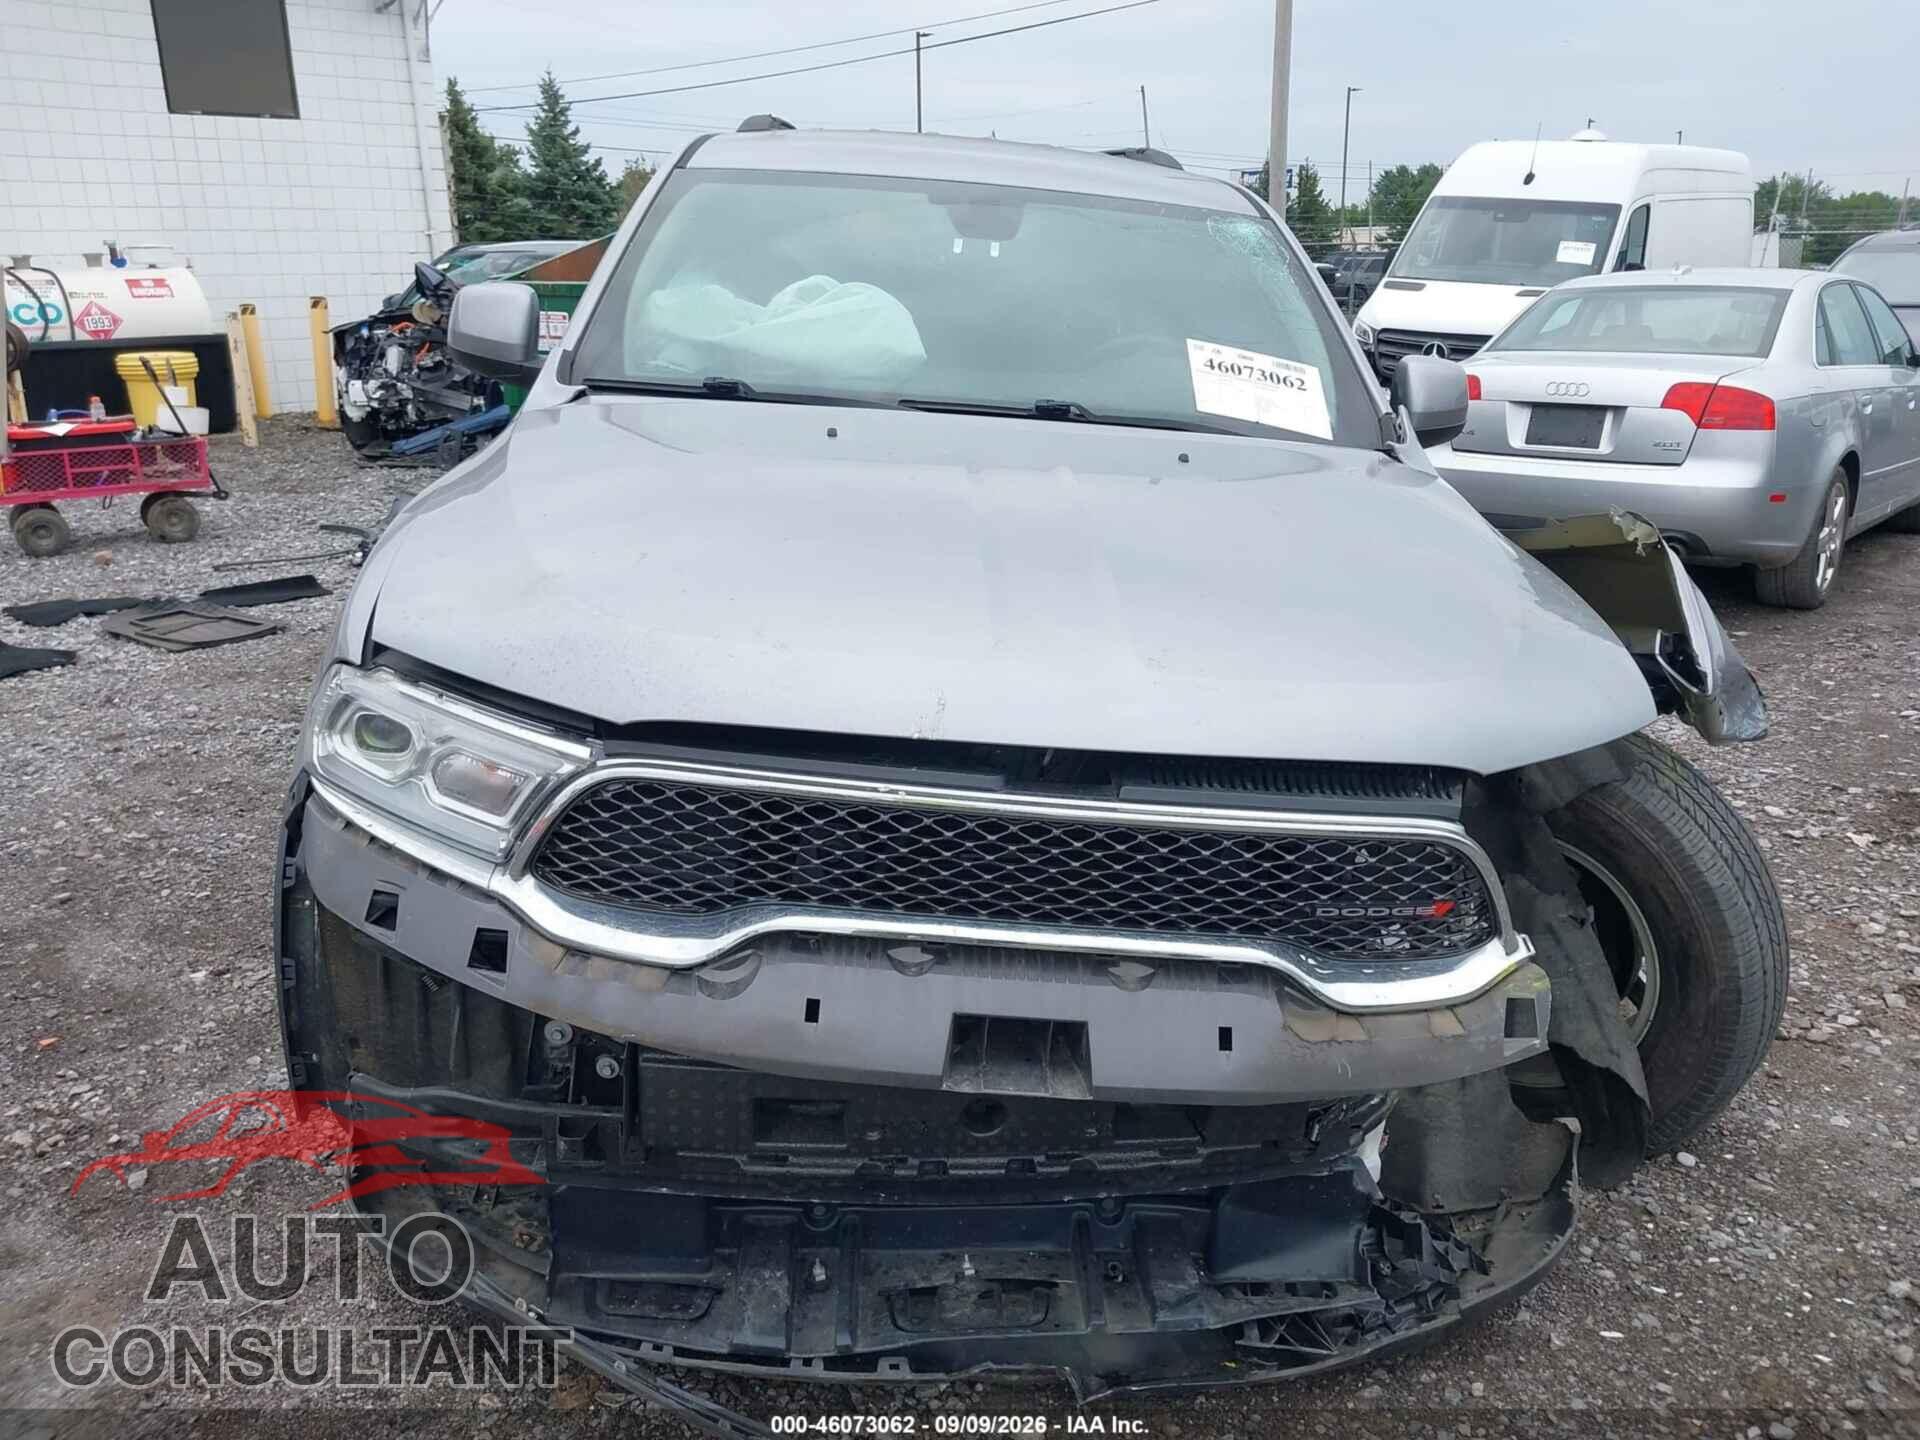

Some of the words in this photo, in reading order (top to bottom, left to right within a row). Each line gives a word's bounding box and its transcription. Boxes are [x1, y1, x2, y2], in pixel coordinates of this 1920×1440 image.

[86, 316, 113, 329] 1993
[1203, 358, 1308, 391] 46073062
[1316, 906, 1436, 916] DODGE
